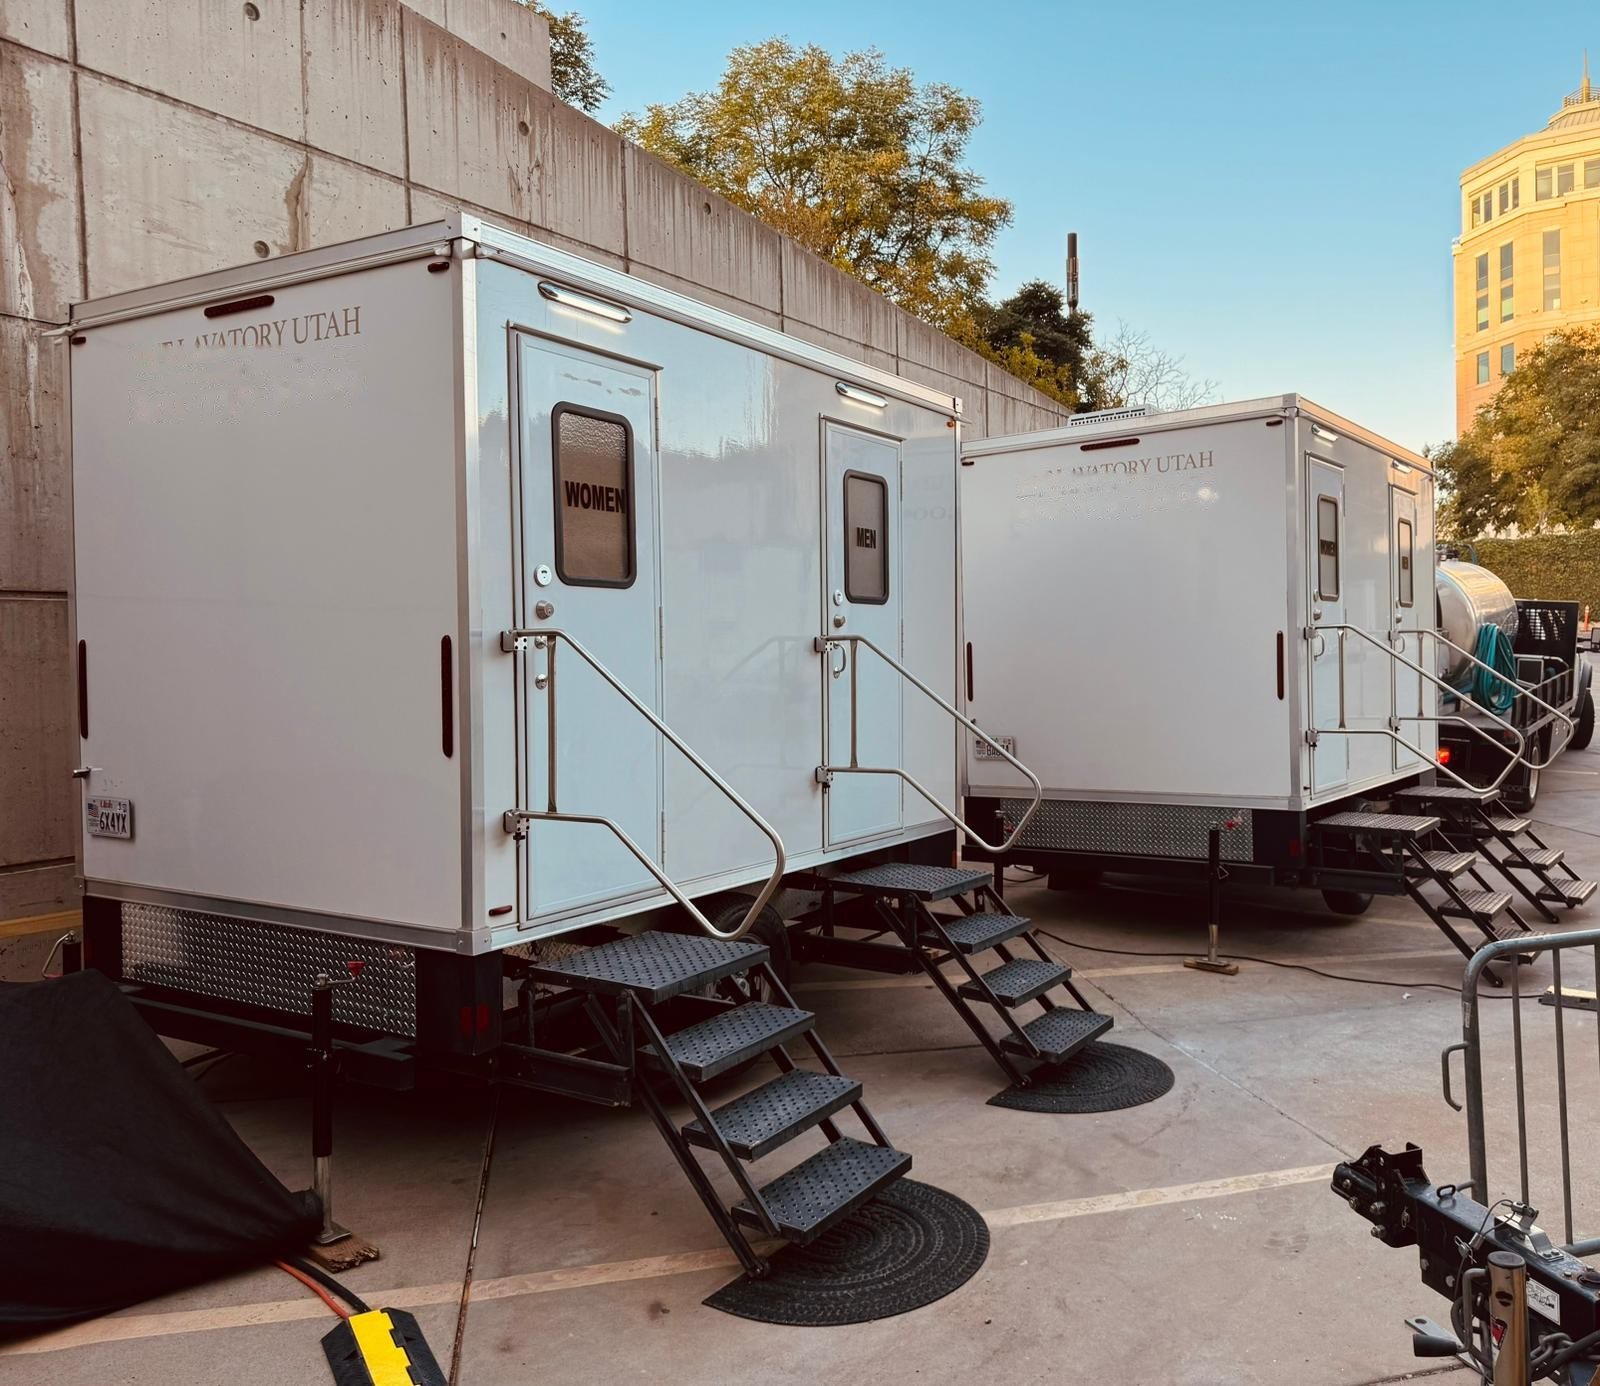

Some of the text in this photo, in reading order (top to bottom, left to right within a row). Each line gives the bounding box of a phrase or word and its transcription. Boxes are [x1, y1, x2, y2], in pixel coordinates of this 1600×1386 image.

[177, 306, 361, 348] ATORY UTAH
[1157, 451, 1214, 473] UTAH
[564, 480, 626, 514] WOMEN
[856, 527, 876, 549] MEN
[99, 811, 127, 833] 6X4YX
